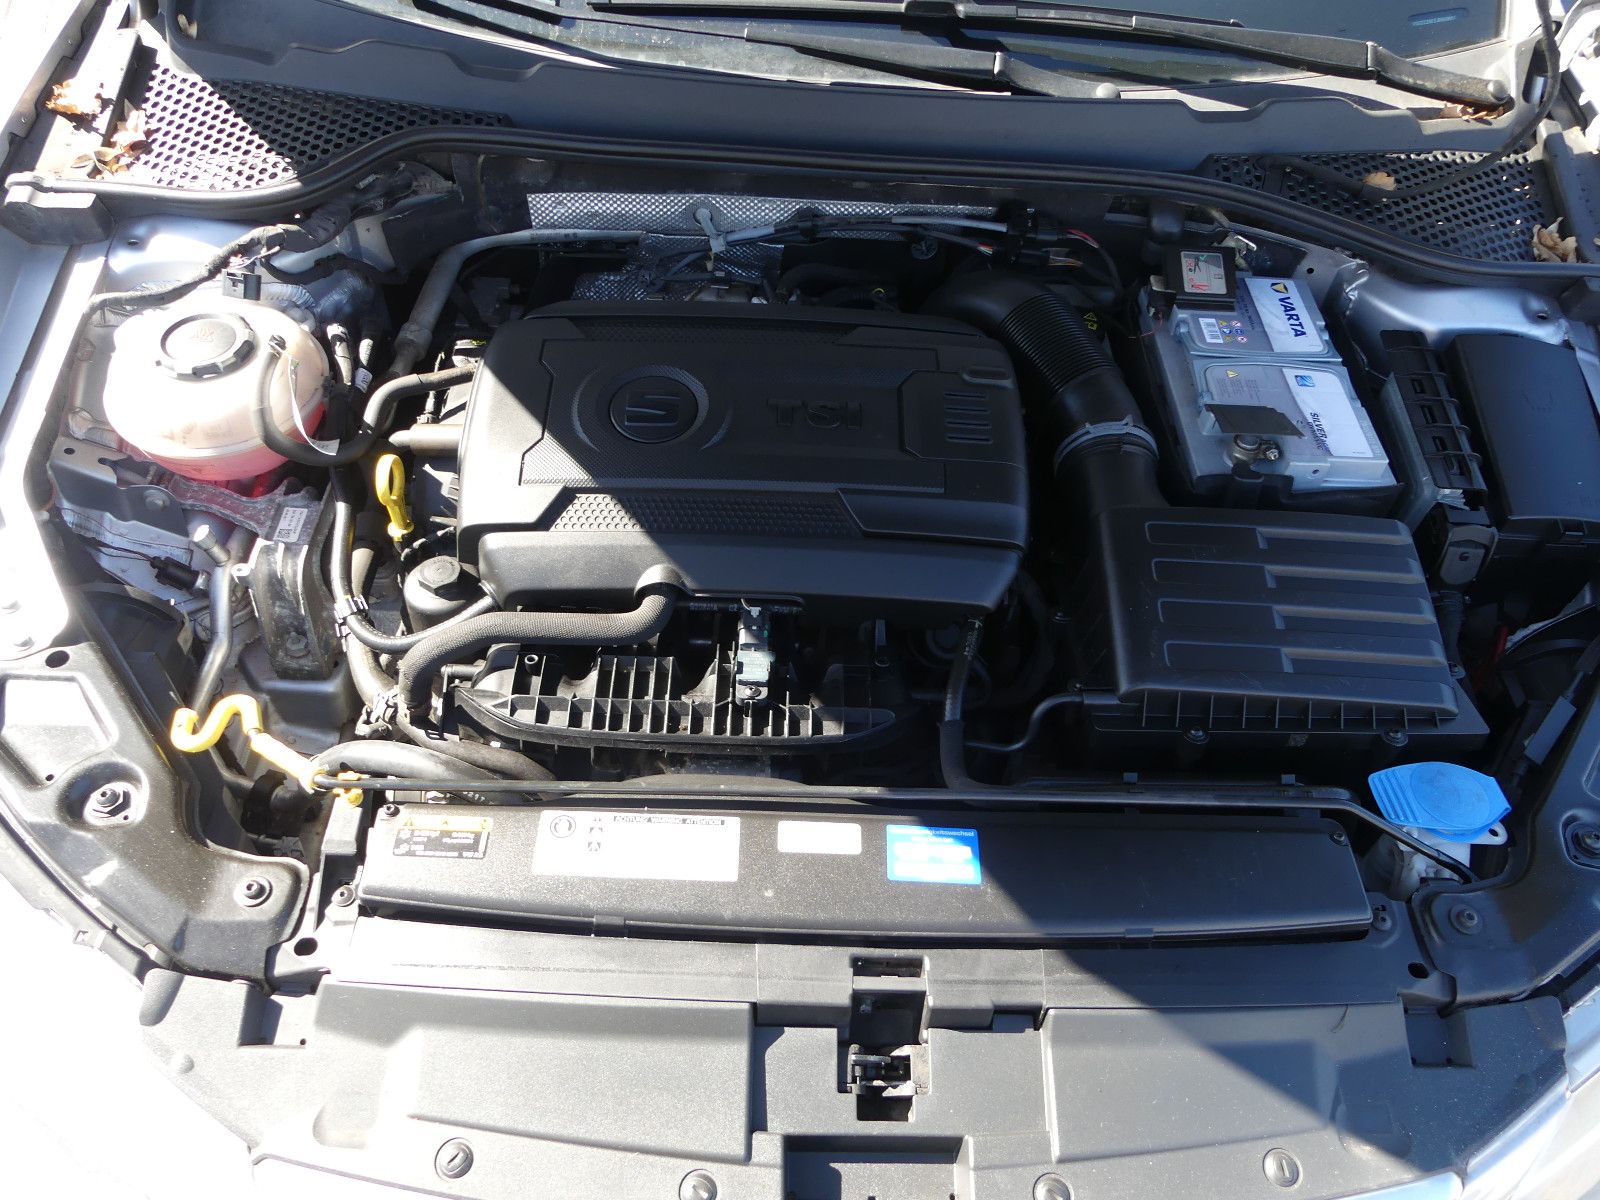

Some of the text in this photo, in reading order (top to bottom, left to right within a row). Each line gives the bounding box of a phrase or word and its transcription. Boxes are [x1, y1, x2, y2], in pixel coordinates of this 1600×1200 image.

[1278, 296, 1307, 337] VARTA
[766, 398, 864, 431] TSI
[1310, 412, 1328, 439] SILVER
